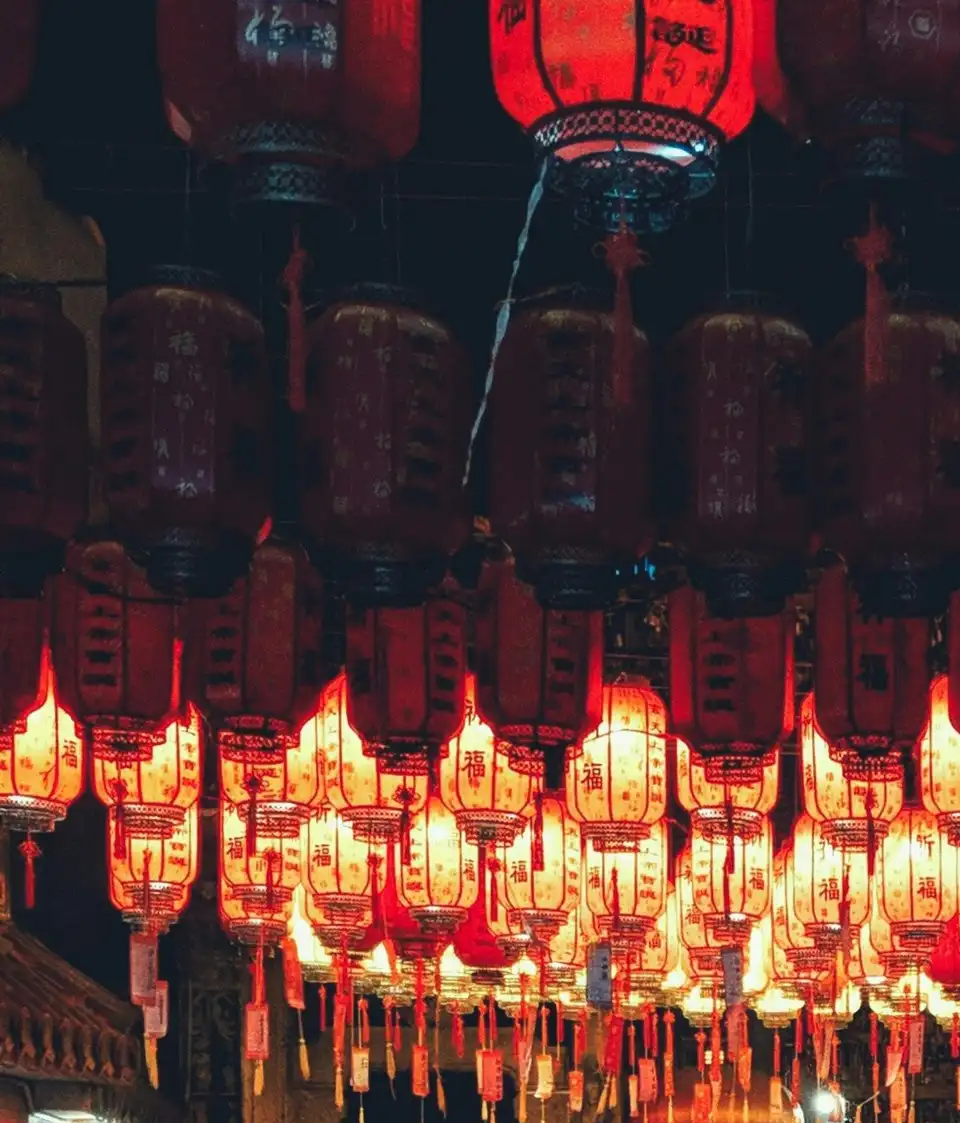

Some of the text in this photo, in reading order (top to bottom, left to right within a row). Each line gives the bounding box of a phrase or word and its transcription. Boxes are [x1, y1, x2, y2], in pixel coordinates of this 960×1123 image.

[581, 763, 604, 791] 福
[463, 859, 476, 882] 福
[509, 860, 528, 884] 福
[588, 864, 601, 889] 福
[916, 833, 938, 900] 祈福
